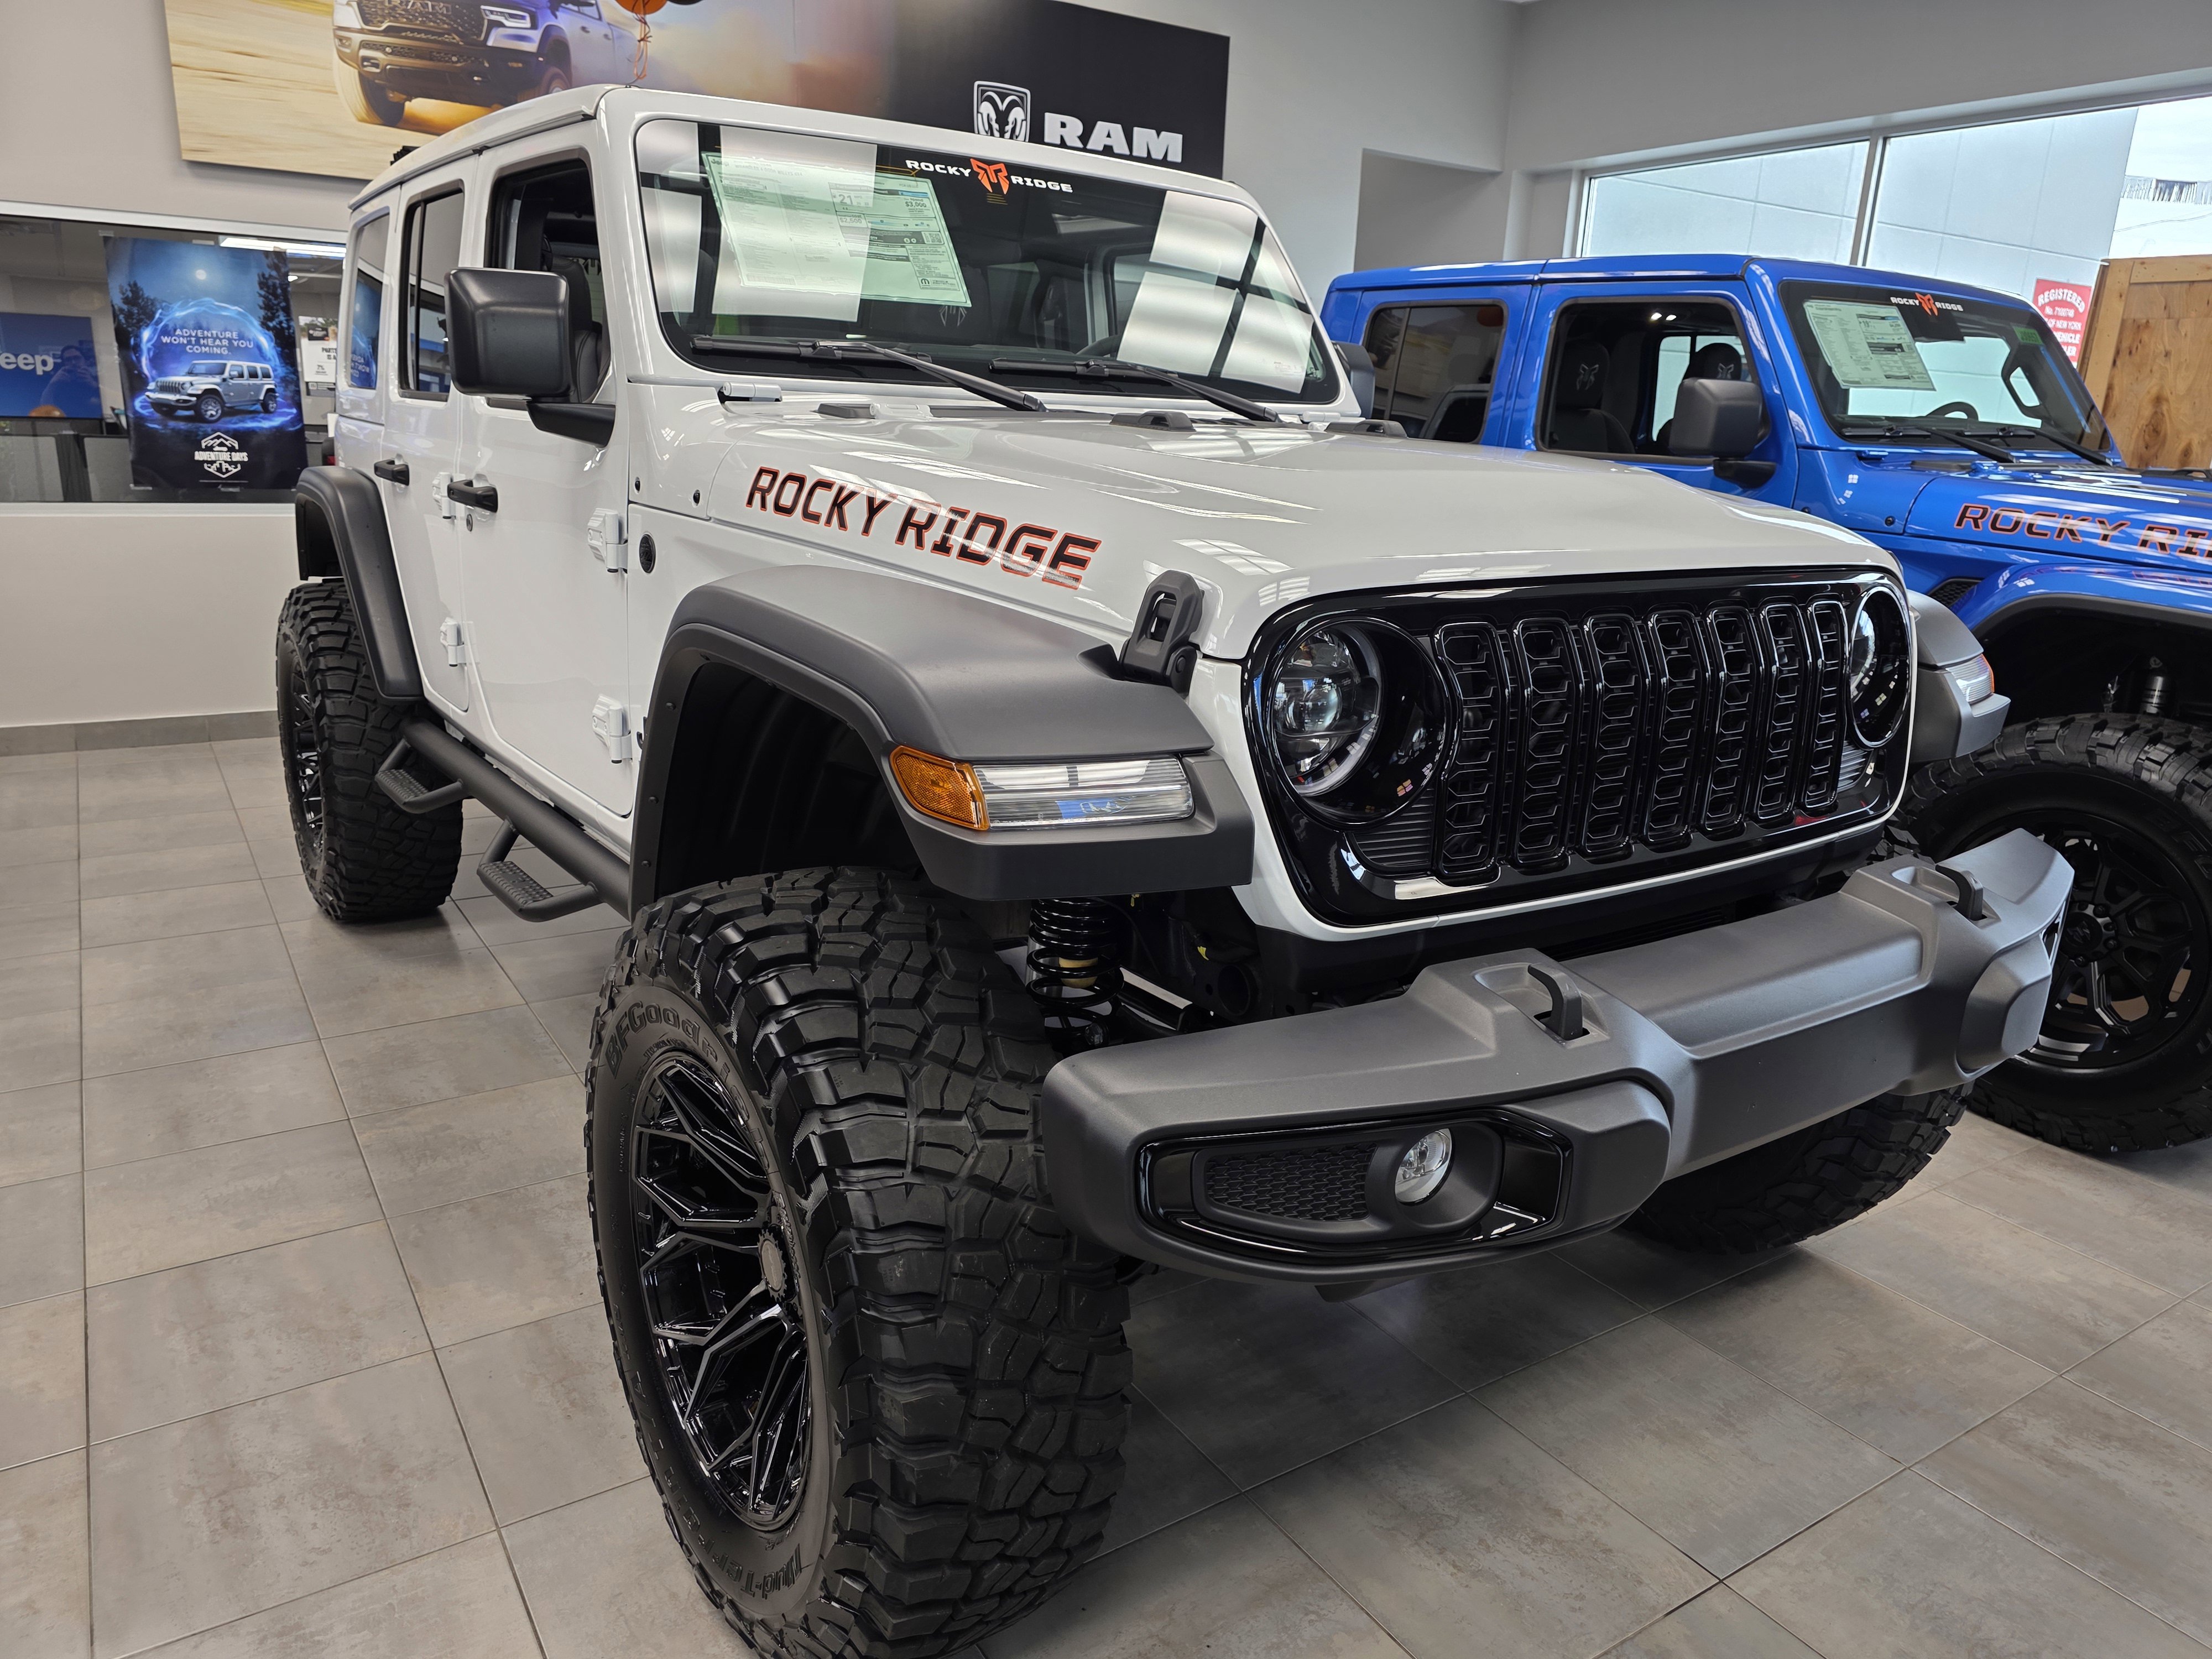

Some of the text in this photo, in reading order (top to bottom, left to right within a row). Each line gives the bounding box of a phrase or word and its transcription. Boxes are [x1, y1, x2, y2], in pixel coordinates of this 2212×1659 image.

[1044, 112, 1183, 163] RAM
[905, 159, 1073, 193] ROCKY RIDGE
[838, 194, 853, 205] 21
[1890, 296, 1964, 311] ROCKY RIDGE
[2037, 288, 2085, 314] REGISTERED
[160, 335, 254, 348] WON'T HEAR YOU
[175, 328, 239, 340] ADVENTURE
[186, 345, 232, 355] COMING.
[0, 351, 54, 375] eep
[194, 451, 249, 462] ADVENTURE DAYS
[745, 466, 1102, 591] ROCKY RIDGE
[1954, 503, 2131, 546] ROCKY
